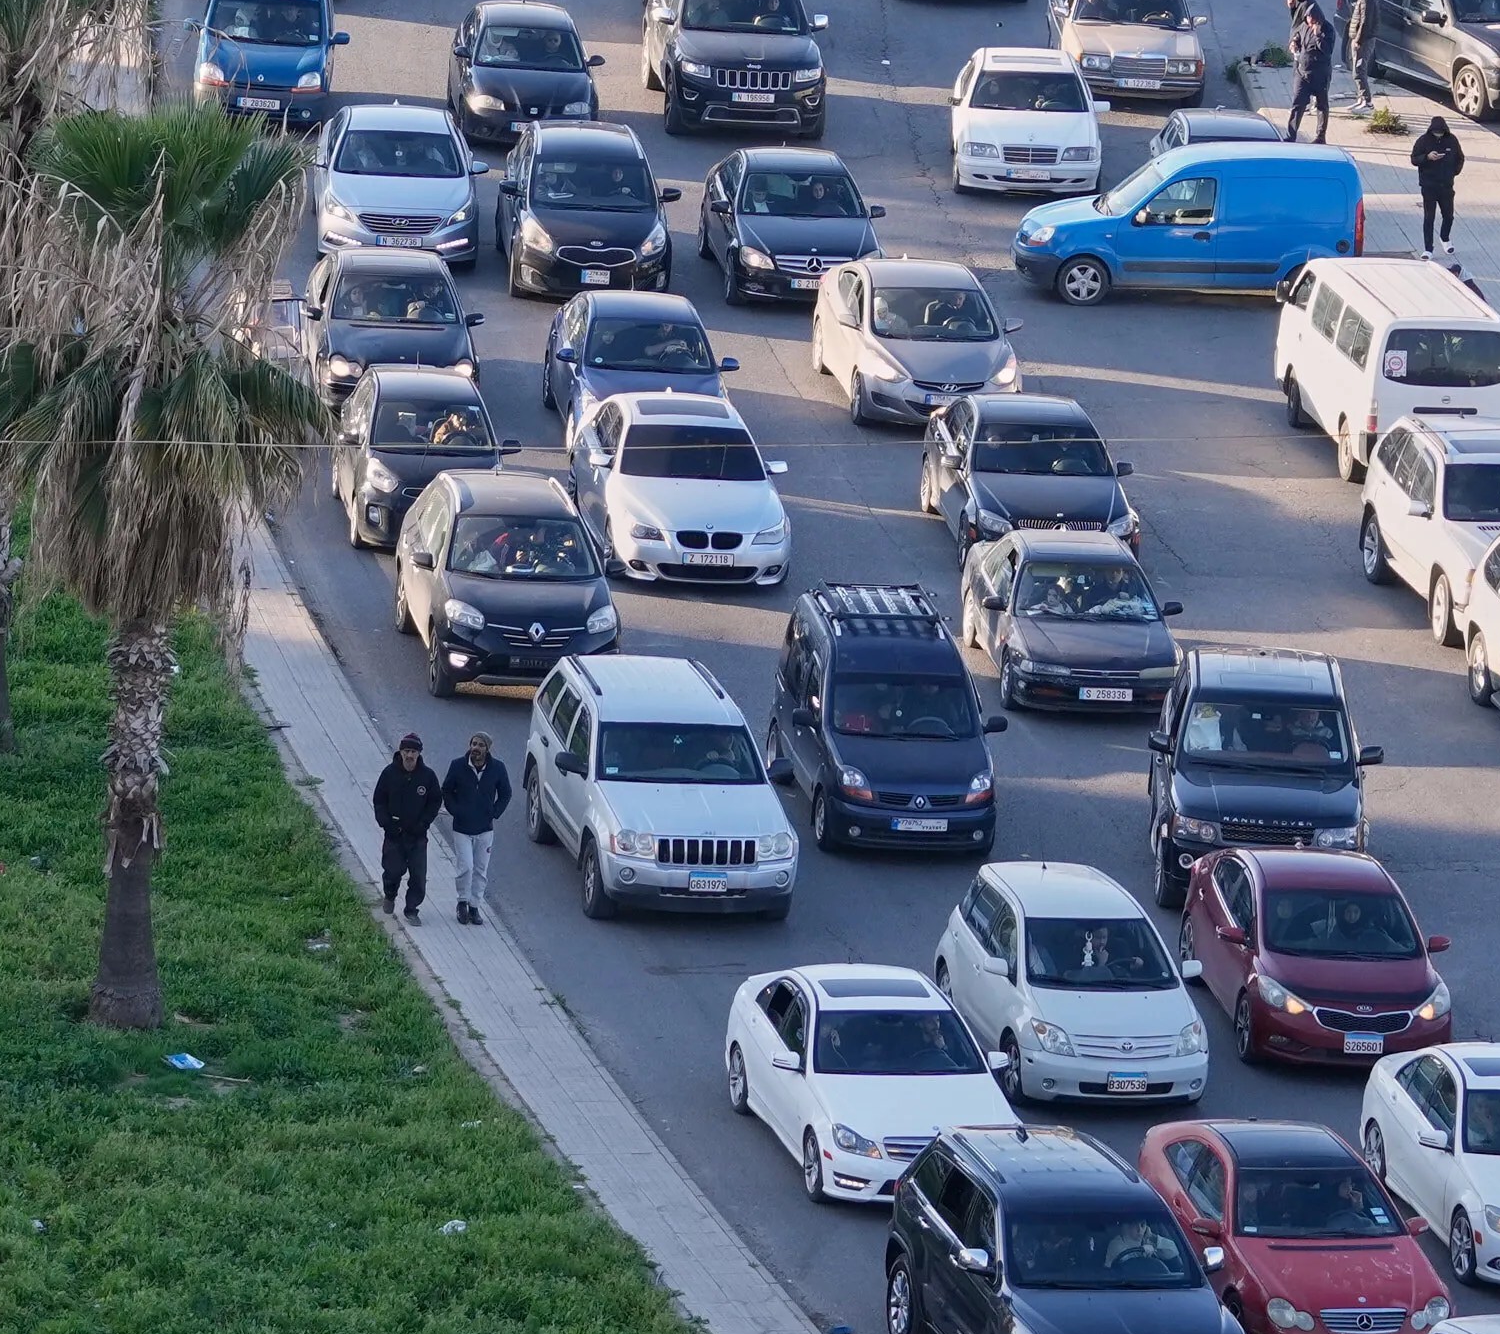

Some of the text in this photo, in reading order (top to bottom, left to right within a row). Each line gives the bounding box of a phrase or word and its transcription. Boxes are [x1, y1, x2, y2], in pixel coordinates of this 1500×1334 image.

[700, 554, 729, 564] 172118
[1085, 689, 1128, 700] S 258336
[1223, 816, 1313, 827] RANGE ROVER
[690, 879, 727, 891] G631979
[1344, 1040, 1383, 1052] S265601
[1108, 1078, 1147, 1090] B307538
